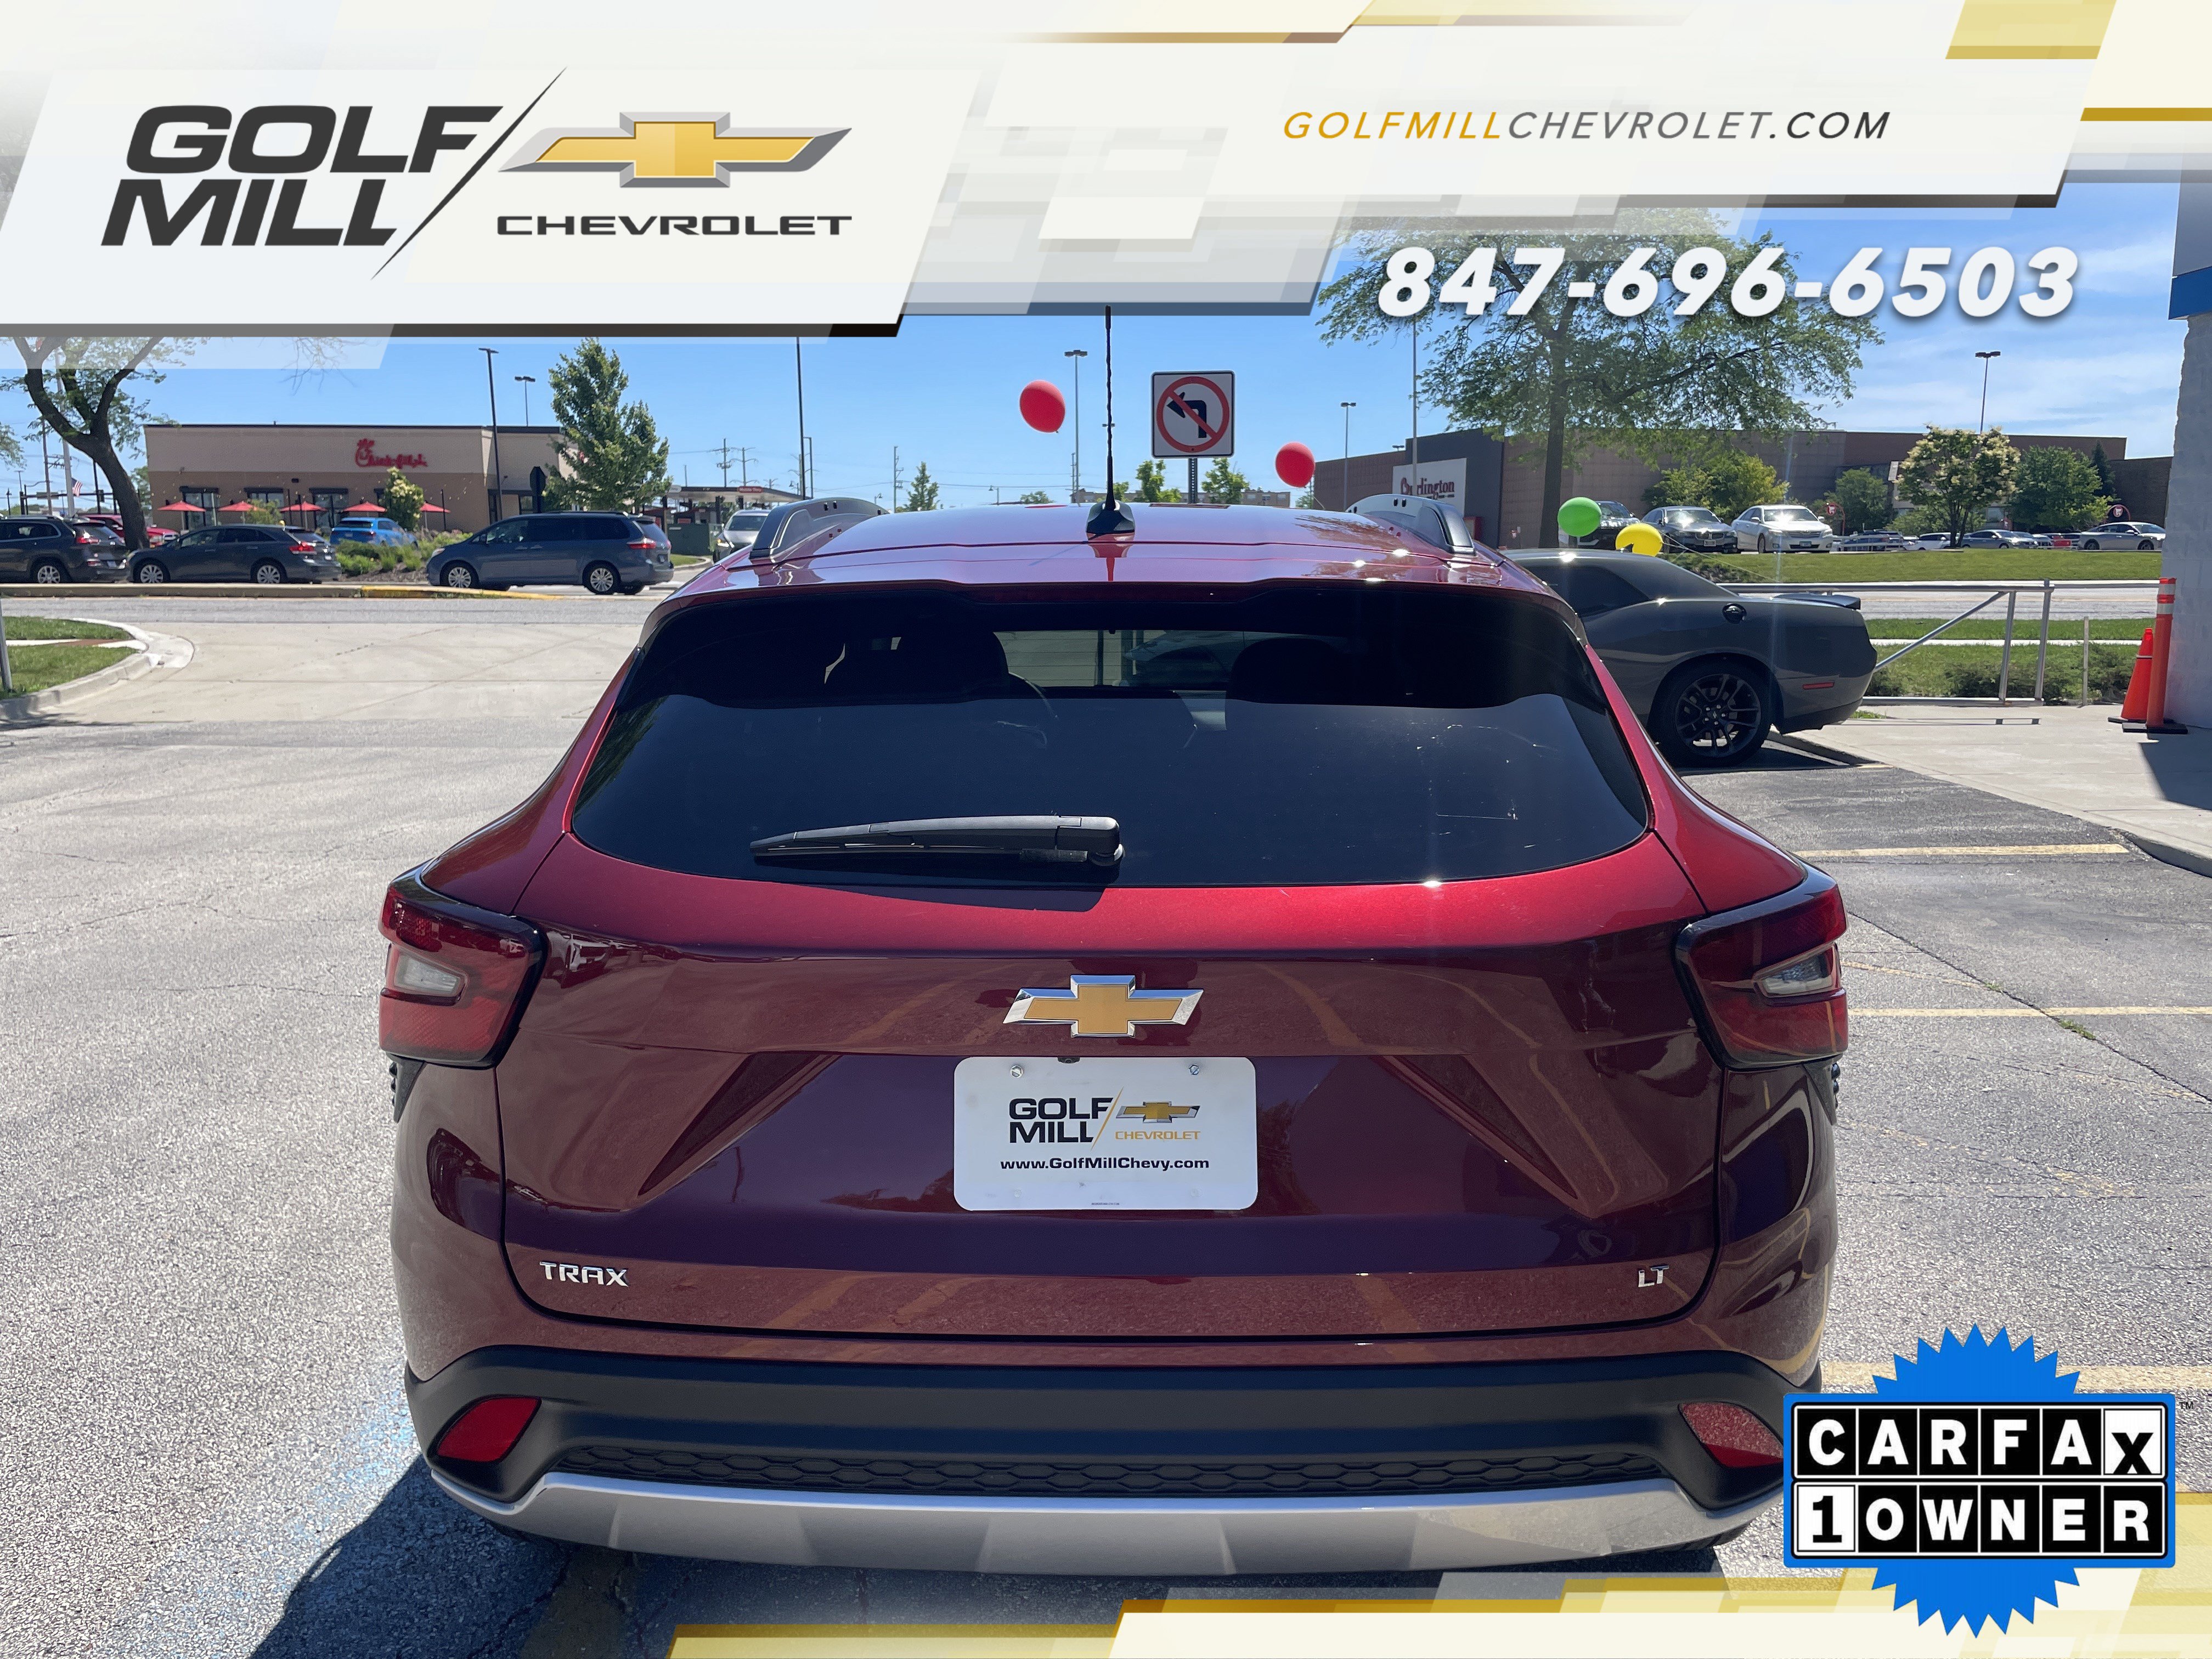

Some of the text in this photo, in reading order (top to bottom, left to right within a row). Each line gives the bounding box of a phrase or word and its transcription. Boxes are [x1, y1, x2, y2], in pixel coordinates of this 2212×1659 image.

[1009, 1097, 1114, 1120] GOLF
[1009, 1121, 1094, 1143] MILL
[1115, 1131, 1201, 1140] CHEVROLET
[1000, 1157, 1209, 1172] www.GolfMillChevy.com
[539, 1261, 629, 1287] TRAX
[1638, 1265, 1670, 1288] LT
